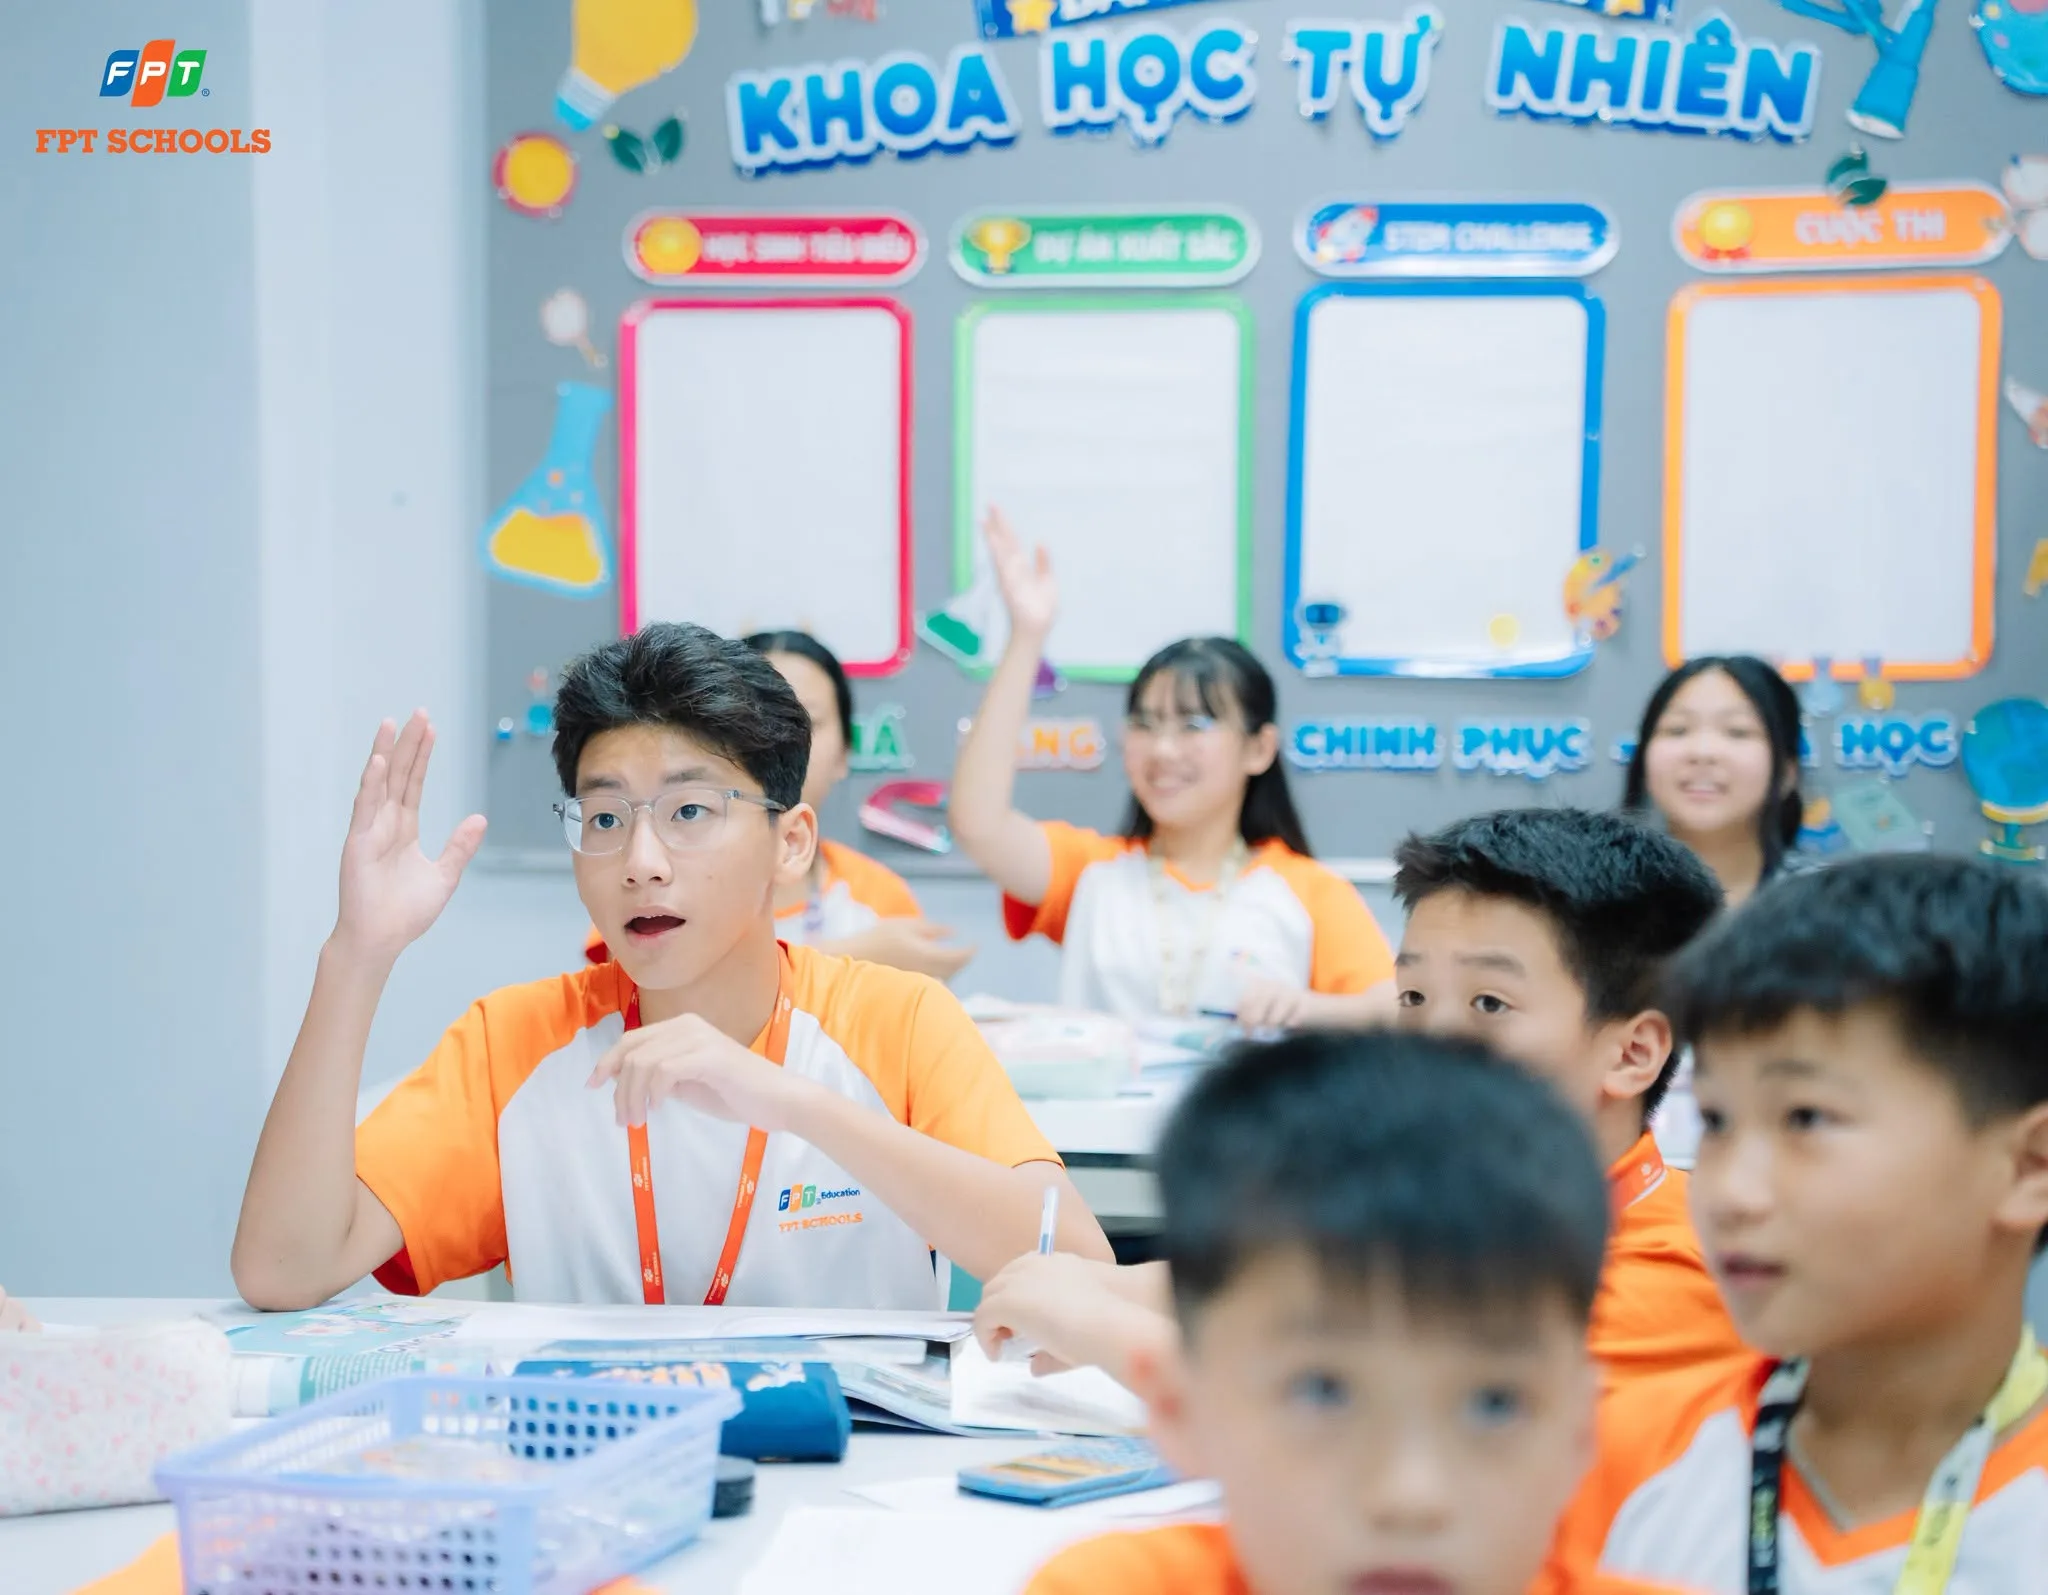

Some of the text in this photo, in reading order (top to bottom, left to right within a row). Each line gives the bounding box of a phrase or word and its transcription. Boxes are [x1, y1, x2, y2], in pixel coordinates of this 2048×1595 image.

[735, 14, 1814, 158] KHOA HỌC TỰ NHIÊN
[1455, 221, 1593, 251] CHALLENGE
[1892, 209, 1947, 242] THI
[1294, 725, 1437, 758] CHINH
[1841, 718, 1951, 765] HỌC
[821, 1187, 861, 1200] Education
[801, 1212, 864, 1230] SCHOOLS
